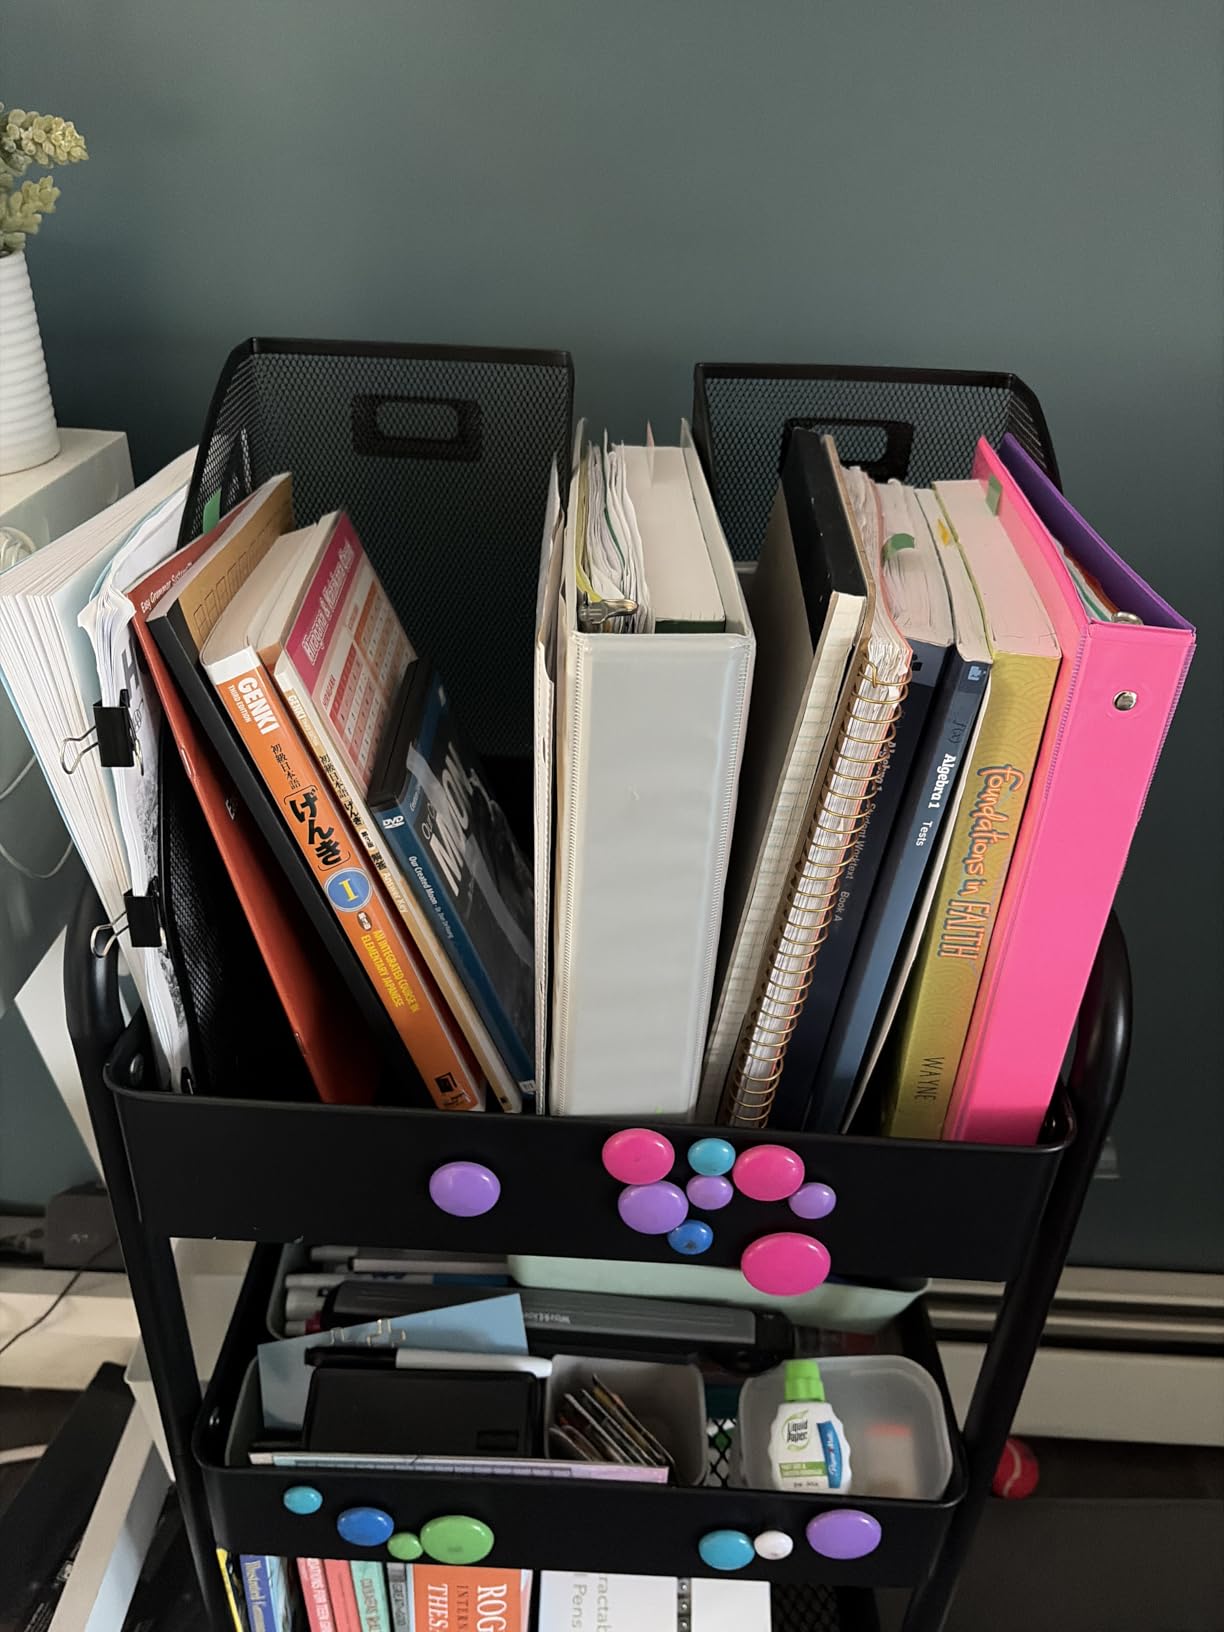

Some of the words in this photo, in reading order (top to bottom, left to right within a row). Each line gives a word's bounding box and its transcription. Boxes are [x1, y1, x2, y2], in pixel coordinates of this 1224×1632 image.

[140, 601, 154, 614] Easy
[150, 580, 173, 603] Grammar
[302, 609, 329, 666] Hiragana
[228, 684, 240, 701] THIRD
[236, 700, 251, 723] EDITION
[238, 677, 280, 735] GENKI
[287, 695, 306, 719] GENKI
[931, 754, 956, 801] Algebra
[382, 815, 405, 829] DVD
[860, 802, 877, 838] Student
[915, 820, 932, 847] Tests
[408, 855, 419, 868] Our
[414, 866, 431, 888] Created
[425, 887, 439, 904] Moon
[845, 839, 865, 880] Worktext
[381, 871, 402, 899] Answer
[835, 890, 849, 912] Book
[958, 878, 984, 896] in
[938, 897, 990, 961] FAITH
[362, 934, 389, 976] ELEMENTARY
[381, 974, 403, 1008] JAPANESE
[377, 940, 405, 980] INTEGRATED
[397, 979, 417, 1004] COURSE
[914, 1056, 945, 1102] WAYNE
[787, 1420, 808, 1432] Liquid
[427, 1583, 448, 1632] THES
[572, 1584, 587, 1628] Pens
